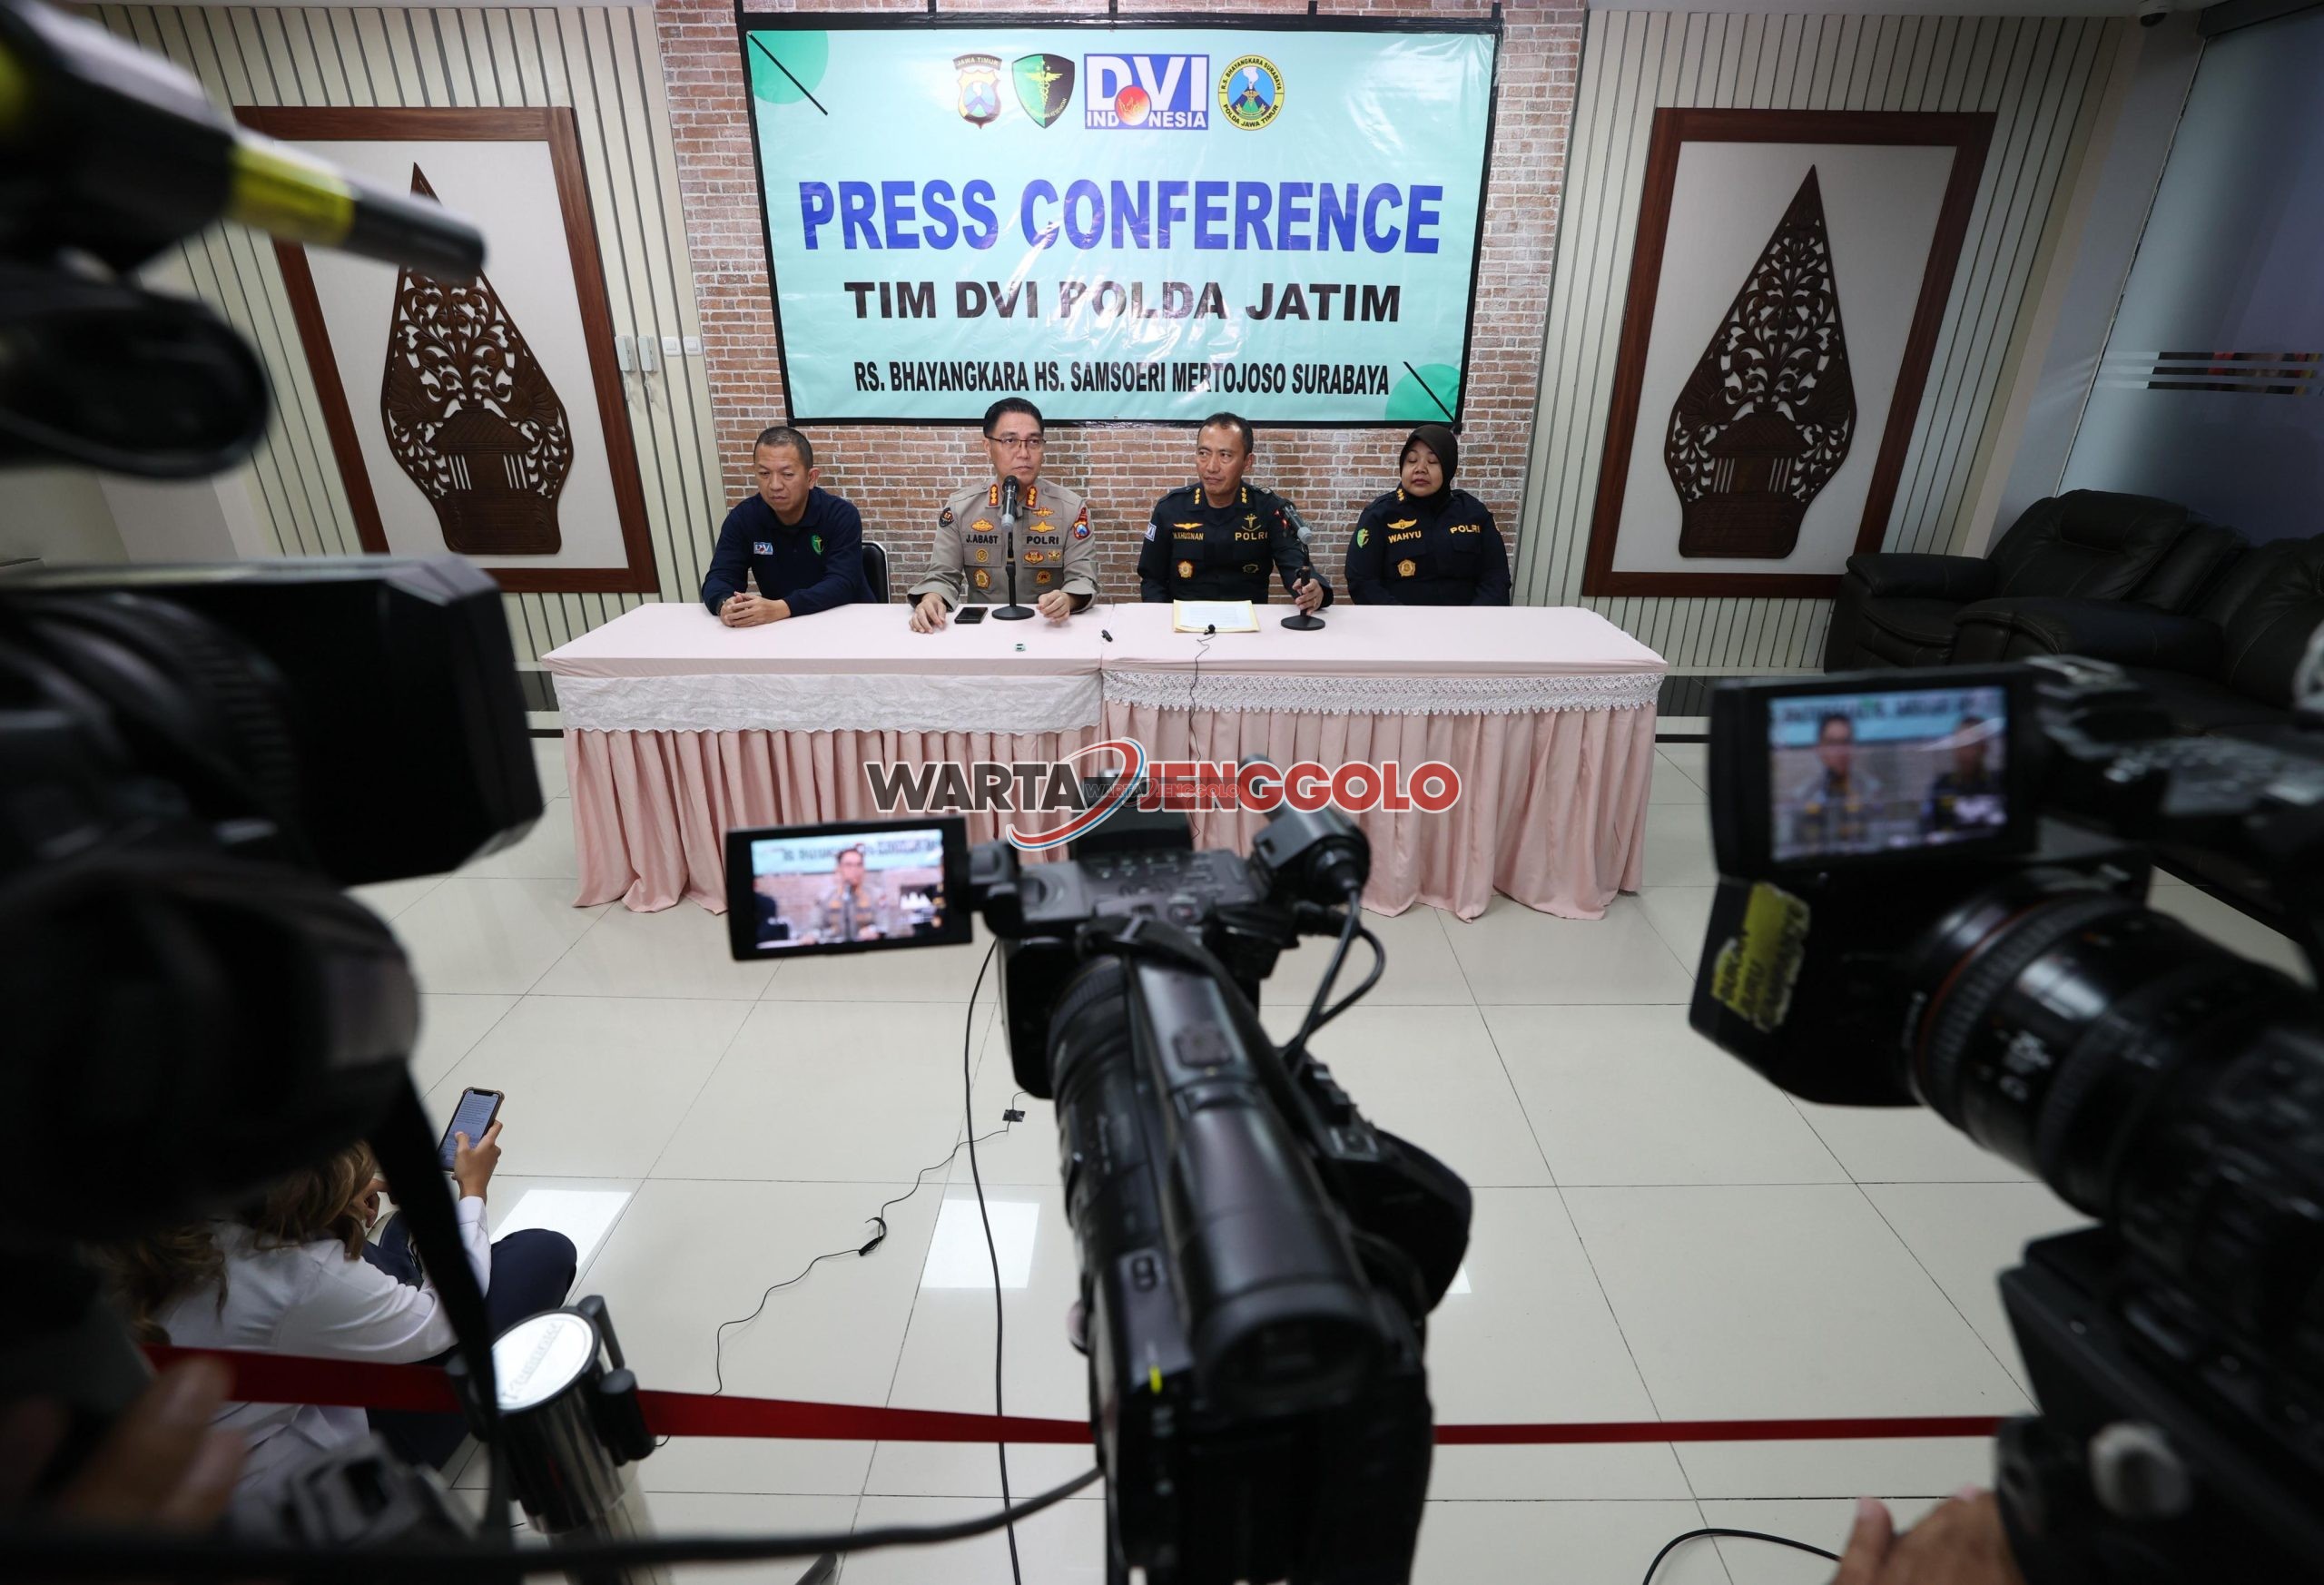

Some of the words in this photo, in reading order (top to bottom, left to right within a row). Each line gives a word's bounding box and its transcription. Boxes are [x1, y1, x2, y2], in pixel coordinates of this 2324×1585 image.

[956, 57, 975, 66] JAWA
[976, 57, 1000, 66] TIMUR
[1086, 55, 1207, 112] DVI
[1226, 58, 1263, 78] BHAYANGKARA
[1263, 63, 1282, 91] SURABAYA
[1223, 103, 1240, 124] POLDA
[1240, 120, 1261, 128] JAWA
[1260, 104, 1279, 124] TIMUR
[799, 180, 998, 250] PRESS
[1021, 180, 1443, 254] CONFERENCE
[844, 281, 936, 318] TIM
[956, 281, 1038, 318] DVI
[1059, 281, 1226, 320] POLDA
[1246, 283, 1400, 321] JATIM
[854, 361, 884, 391] RS.
[889, 361, 1029, 391] BHAYANGKARA
[1035, 361, 1065, 392] HS.
[1070, 361, 1166, 392] SAMSOERI
[1172, 362, 1285, 393] MERTOJOSO
[1292, 364, 1389, 395] SURABAYA
[1027, 536, 1059, 545] POLRI
[1235, 532, 1268, 541] POLRI
[1388, 531, 1422, 543] WAHYU
[1450, 525, 1481, 534] POLRI
